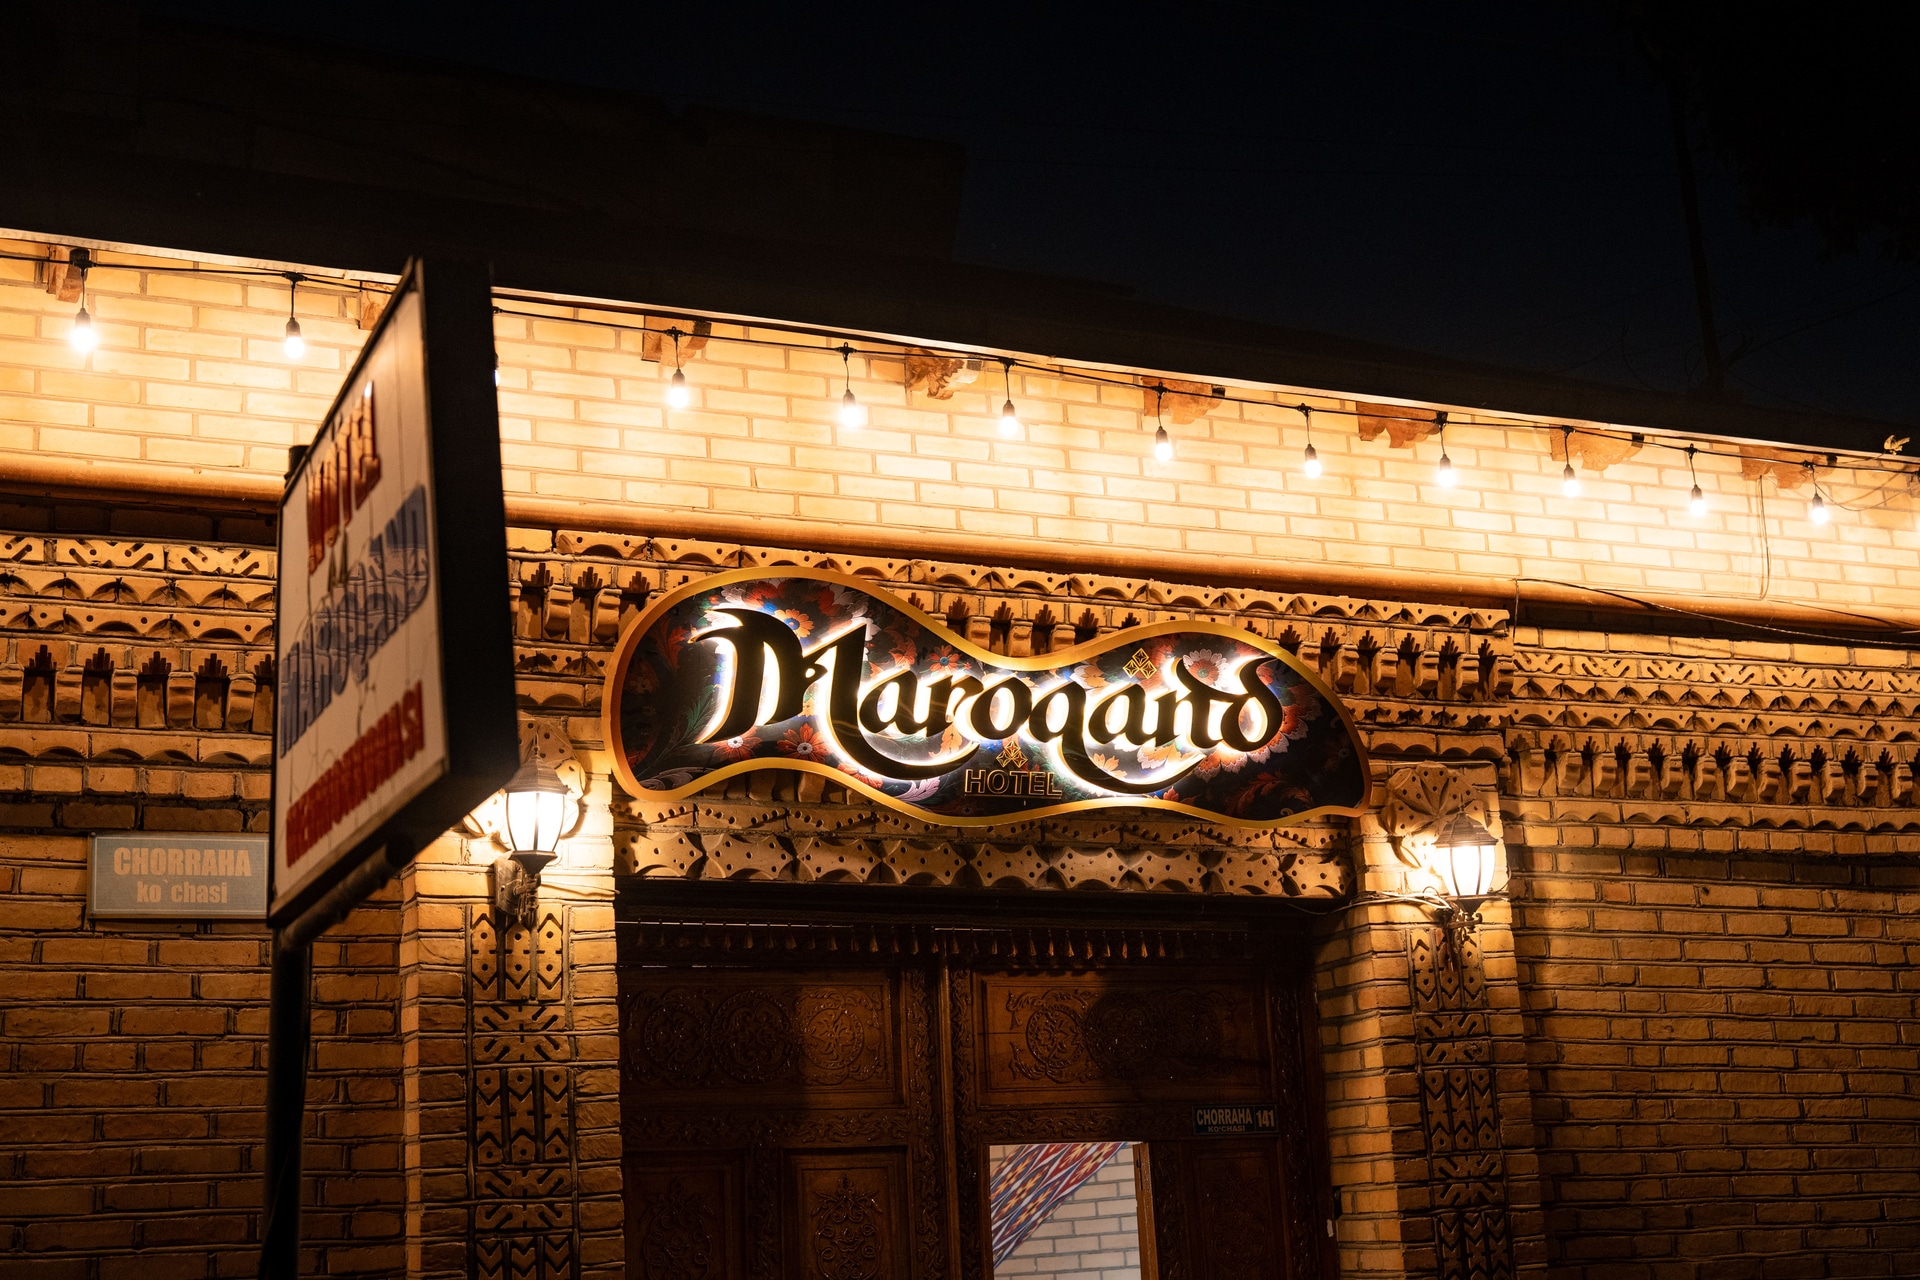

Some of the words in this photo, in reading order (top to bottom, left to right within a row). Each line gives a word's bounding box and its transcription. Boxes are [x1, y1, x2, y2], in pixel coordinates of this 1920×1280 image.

[964, 768, 1063, 796] HOTEL
[113, 846, 251, 877] CHORRAHA
[1196, 1107, 1253, 1126] CHORRAHA
[1256, 1109, 1275, 1128] 141
